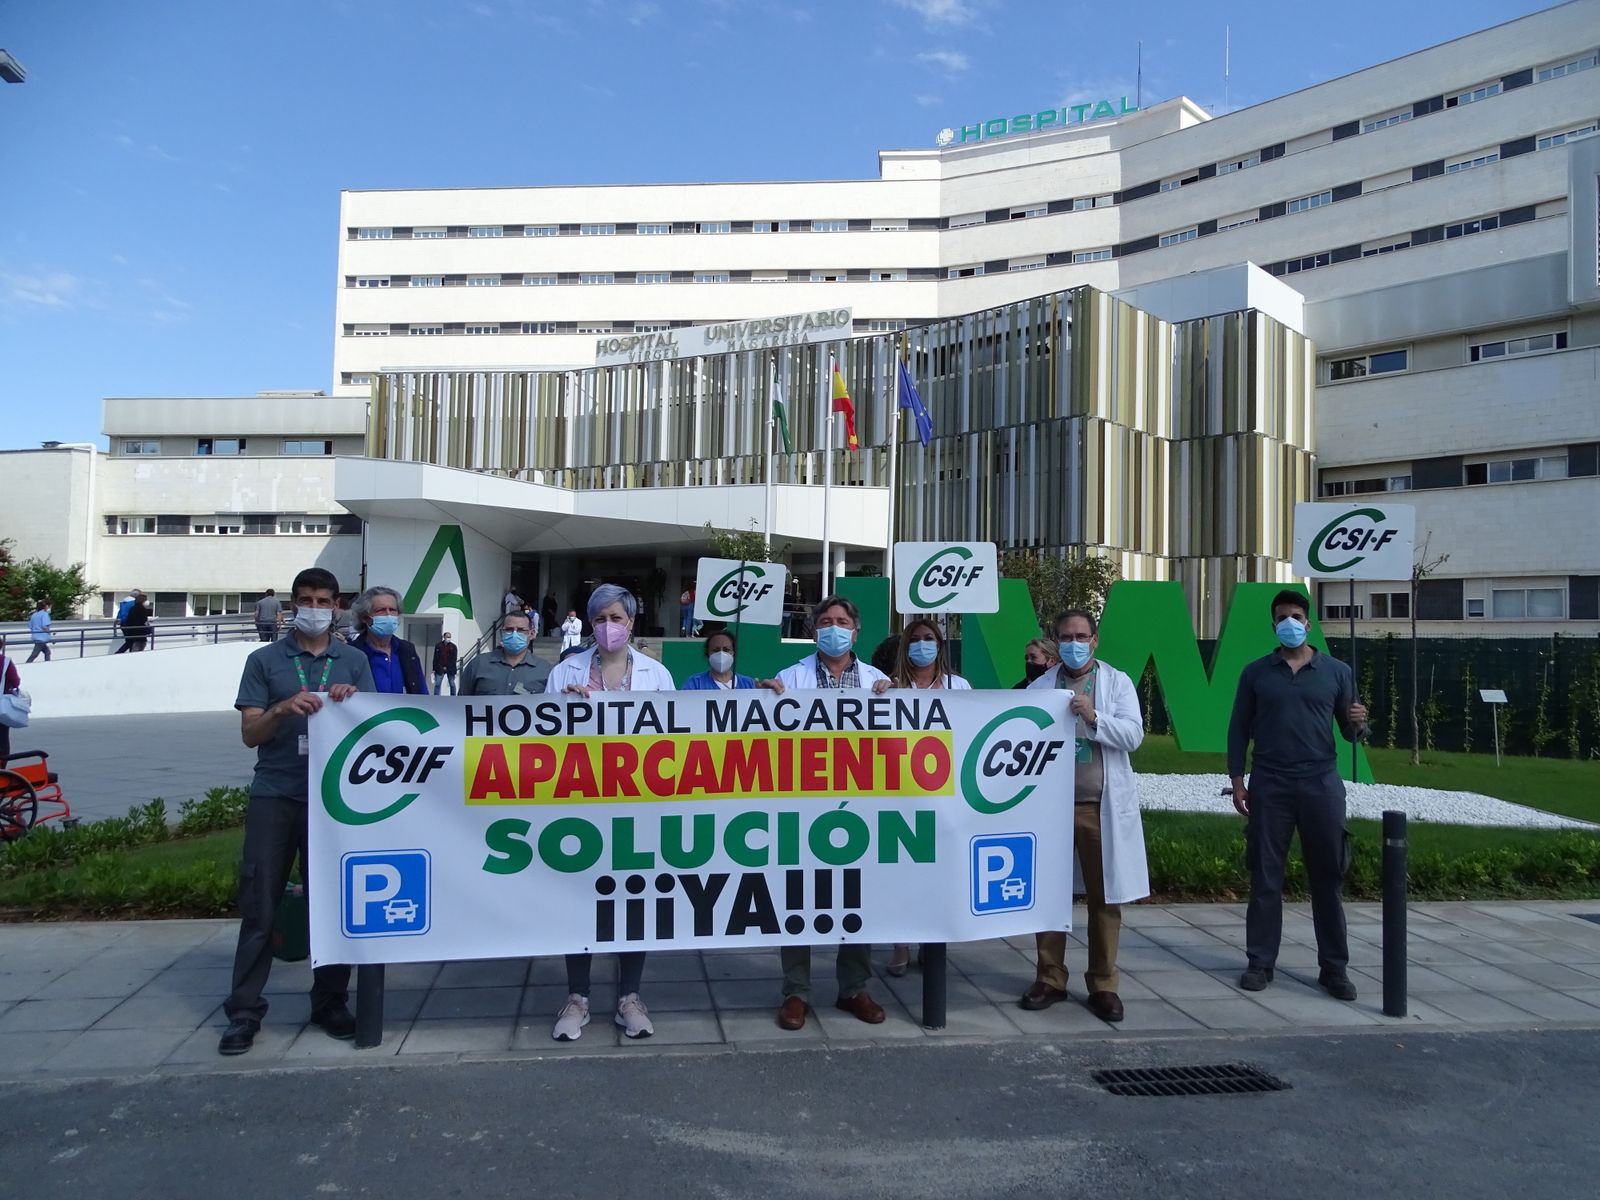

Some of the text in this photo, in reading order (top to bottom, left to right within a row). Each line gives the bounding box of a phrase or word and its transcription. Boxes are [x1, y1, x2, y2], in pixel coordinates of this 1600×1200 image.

[960, 96, 1140, 143] HOSPITAL
[596, 309, 850, 356] HOSPITAL UNIVERSITARIO
[628, 347, 679, 362] VIRGEN
[464, 698, 952, 737] HOSPITAL MACARENA
[348, 743, 454, 785] CSIF
[469, 735, 951, 800] APARCAMIENTO
[982, 738, 1065, 777] CSIF
[482, 801, 936, 875] SOLUCIÓN
